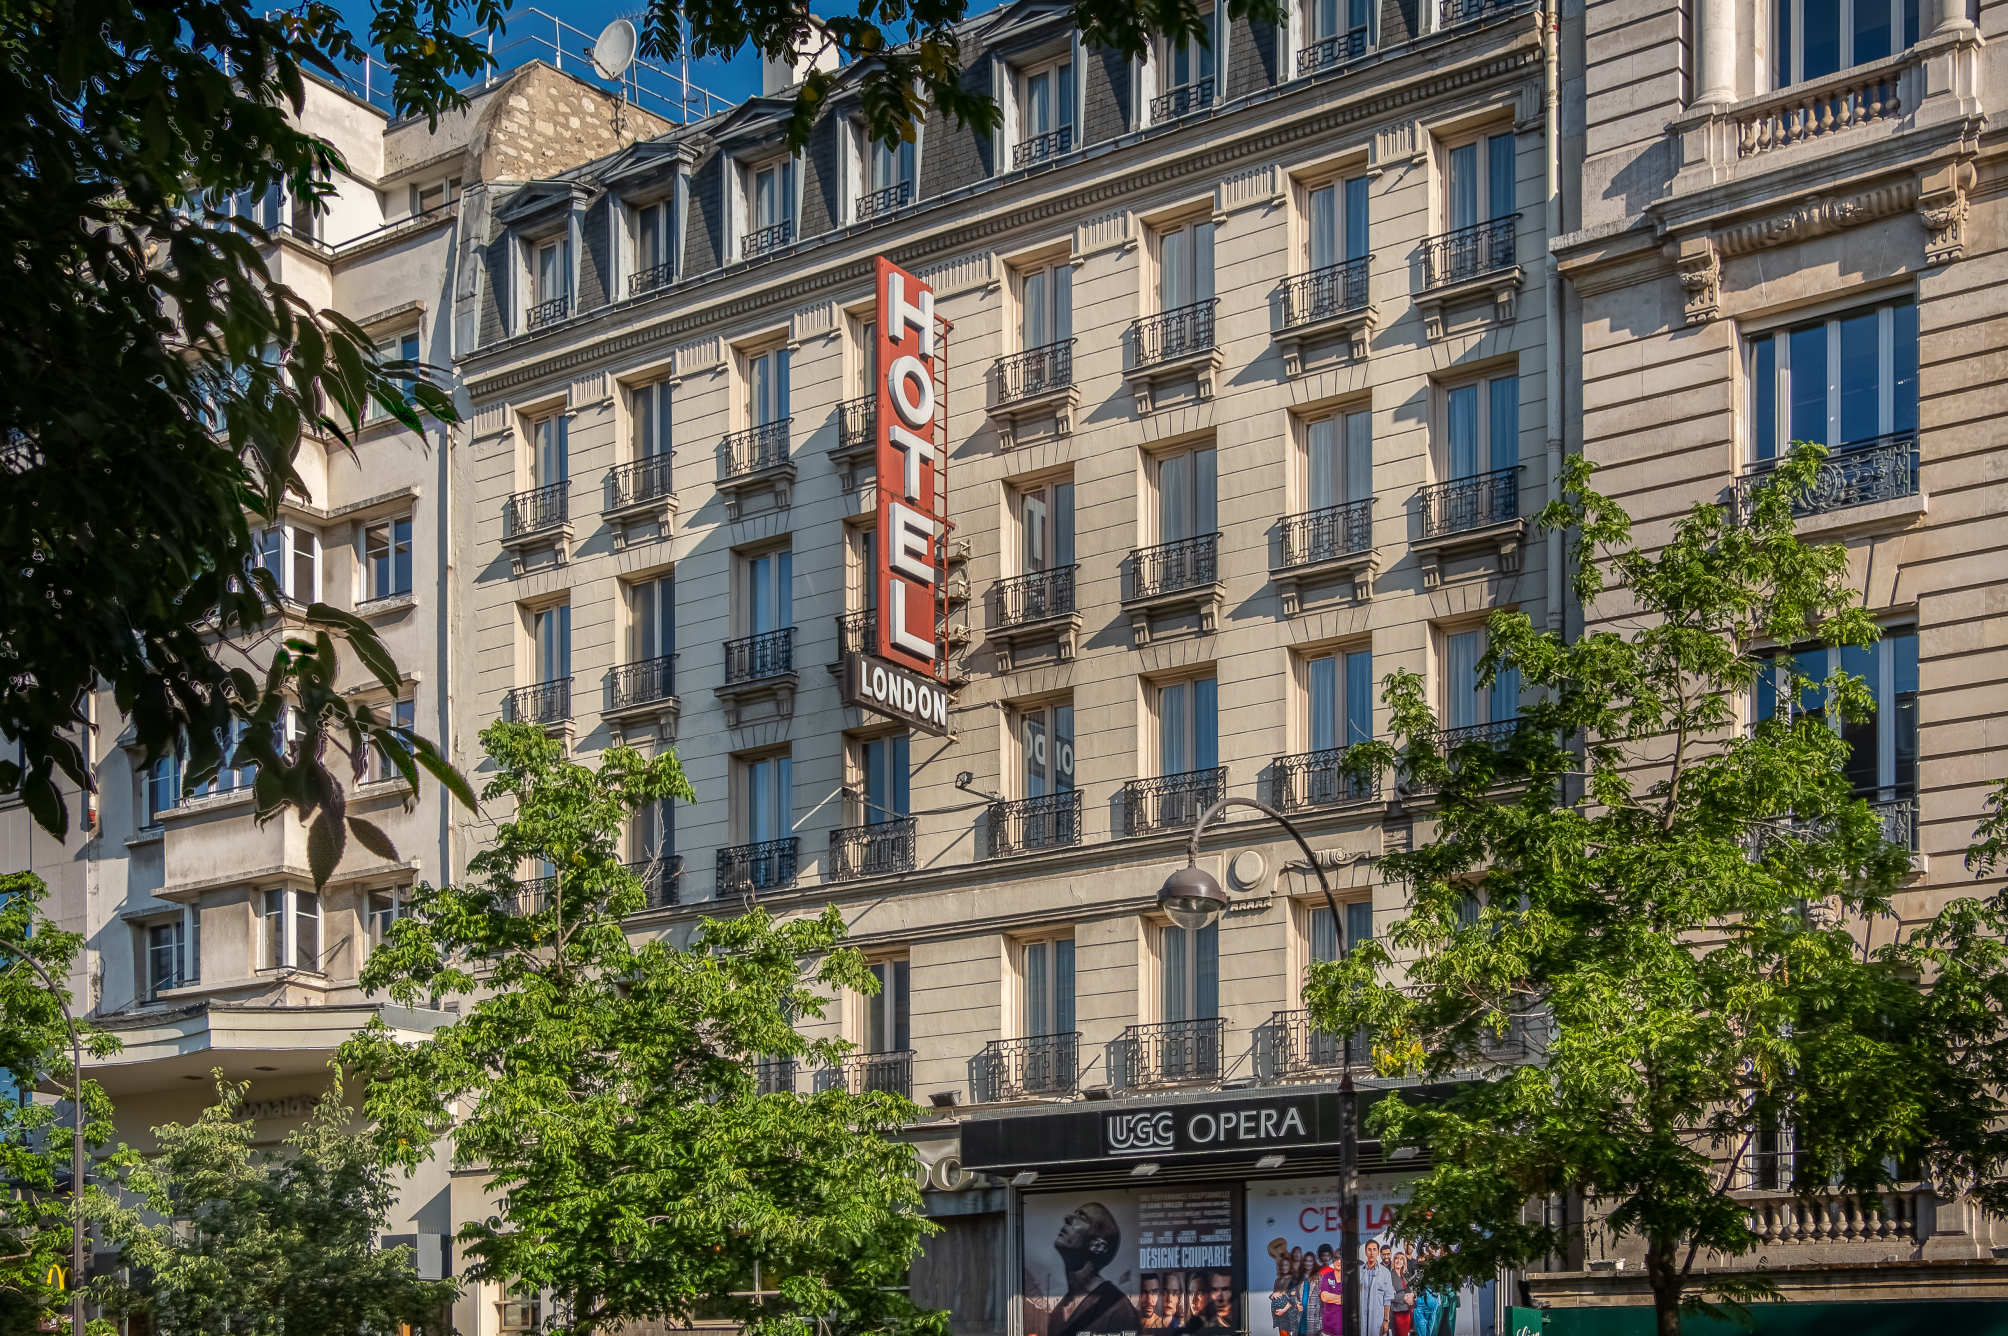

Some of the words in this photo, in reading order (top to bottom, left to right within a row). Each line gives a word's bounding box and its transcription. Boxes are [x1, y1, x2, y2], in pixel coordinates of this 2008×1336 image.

[888, 271, 935, 660] HOTEL
[861, 660, 946, 727] LONDON
[1108, 1111, 1175, 1152] UGC
[1188, 1106, 1307, 1144] OPERA
[1182, 1244, 1233, 1268] COUPABLE
